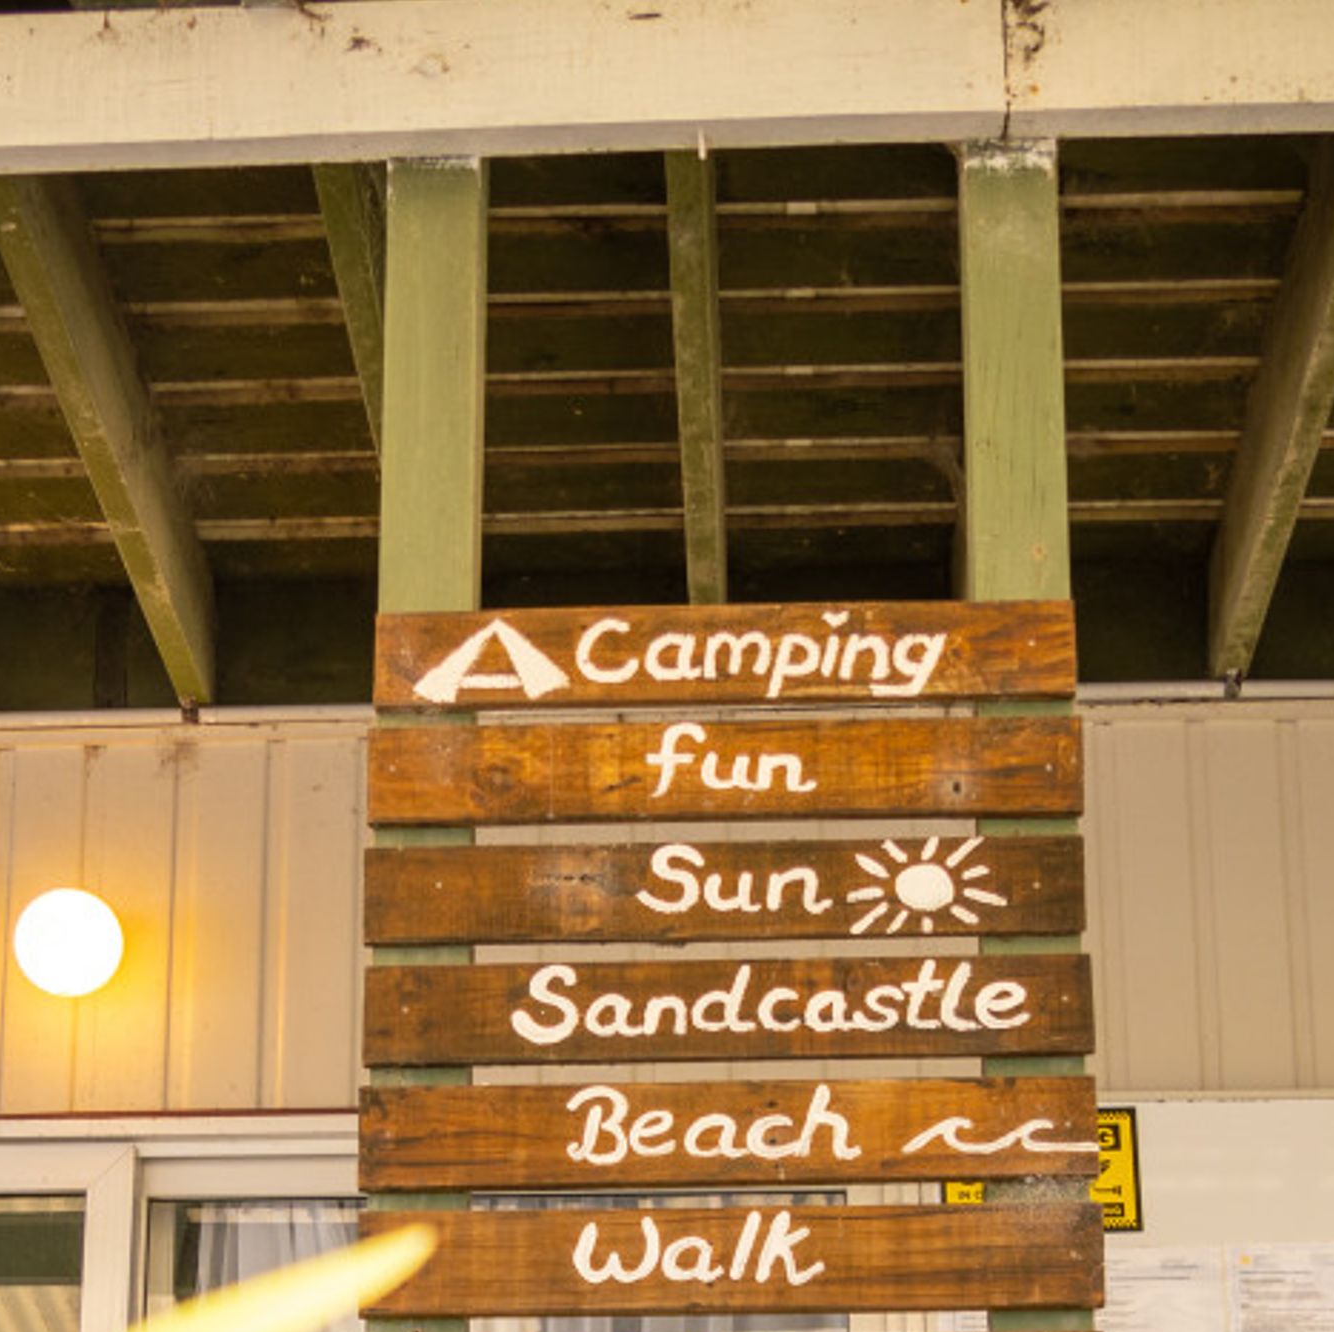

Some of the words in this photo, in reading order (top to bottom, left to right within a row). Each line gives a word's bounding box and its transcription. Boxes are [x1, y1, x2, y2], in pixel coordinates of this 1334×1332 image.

[575, 612, 946, 698] Camping
[646, 721, 817, 797] fun
[636, 843, 834, 915] Sun
[510, 960, 1031, 1046] Sandcastle
[565, 1084, 862, 1165] Beach
[571, 1210, 826, 1287] Walk
